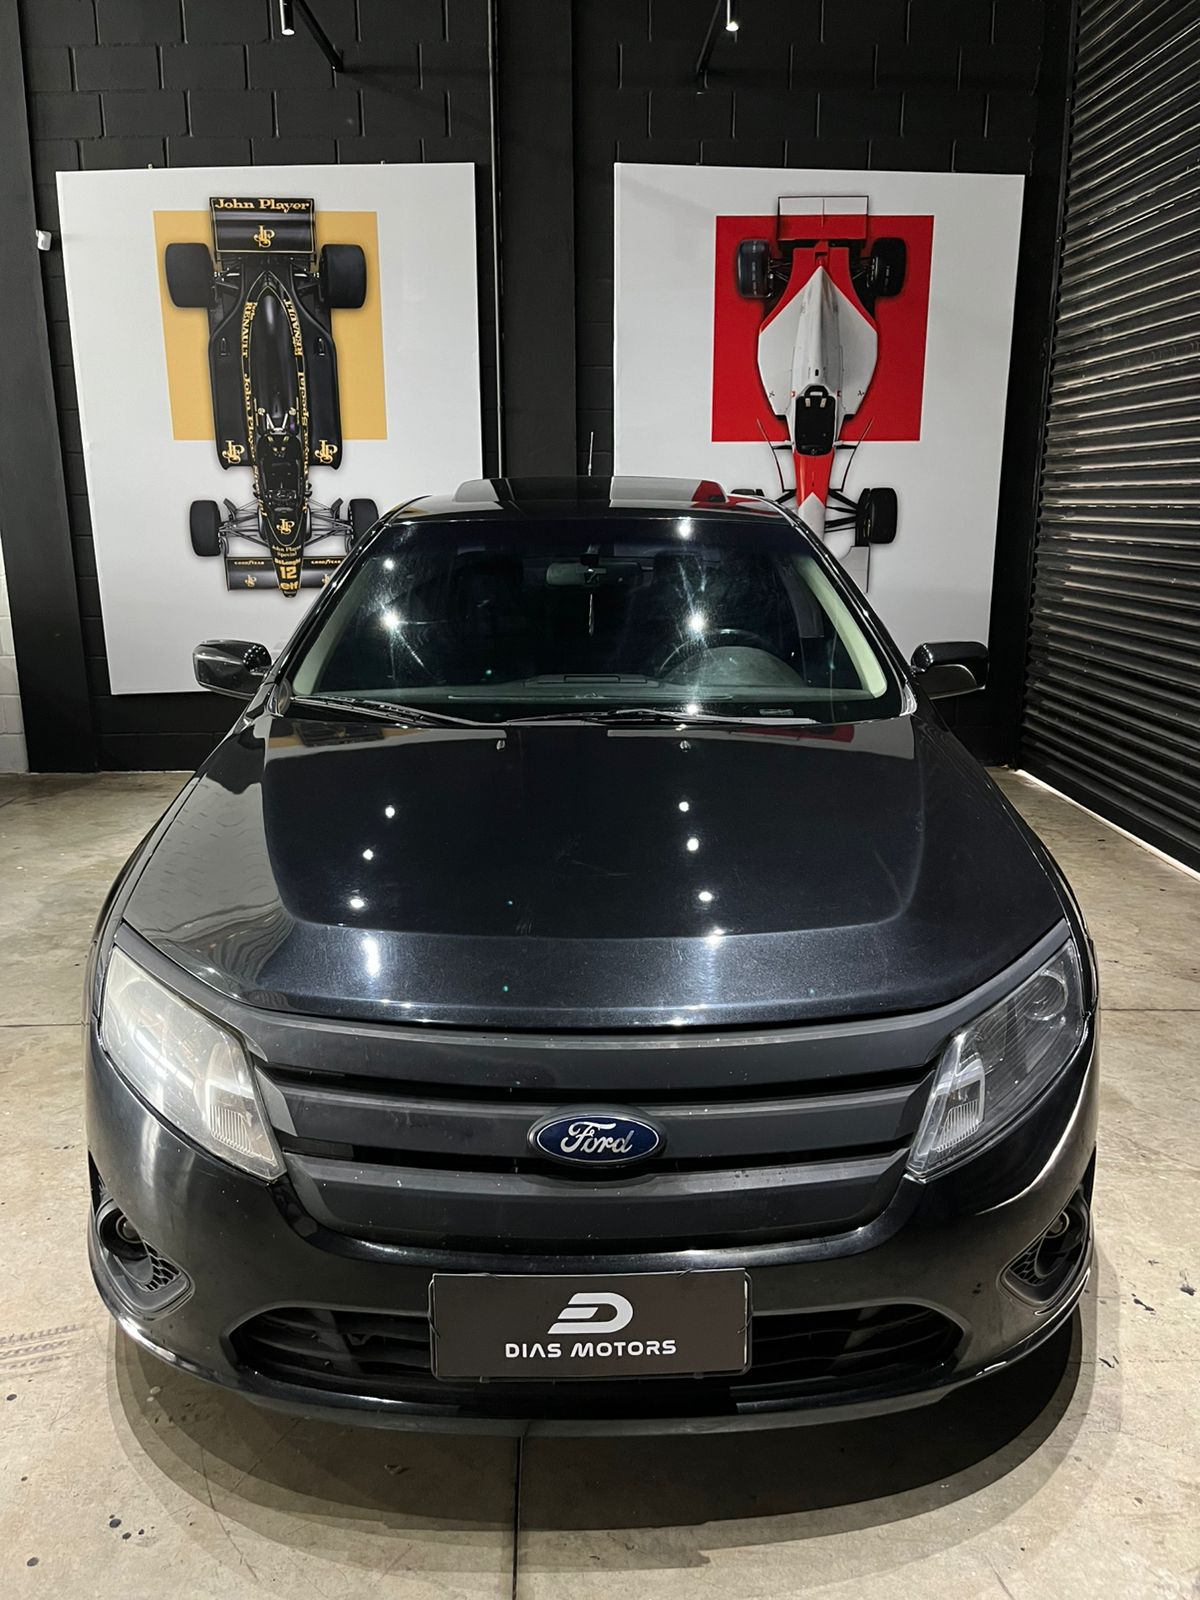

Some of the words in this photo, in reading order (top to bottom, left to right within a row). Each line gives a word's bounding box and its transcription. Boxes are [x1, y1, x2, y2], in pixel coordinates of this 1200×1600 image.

[214, 198, 255, 209] John
[258, 198, 310, 213] Player
[241, 302, 253, 358] RENAULT
[283, 299, 303, 356] RENAULT
[243, 373, 252, 411] John
[297, 371, 309, 426] Special
[280, 566, 297, 578] 12
[280, 581, 299, 590] elf
[560, 1121, 635, 1154] Ford
[505, 1343, 562, 1359] DIAS
[570, 1339, 677, 1359] MOTORS
